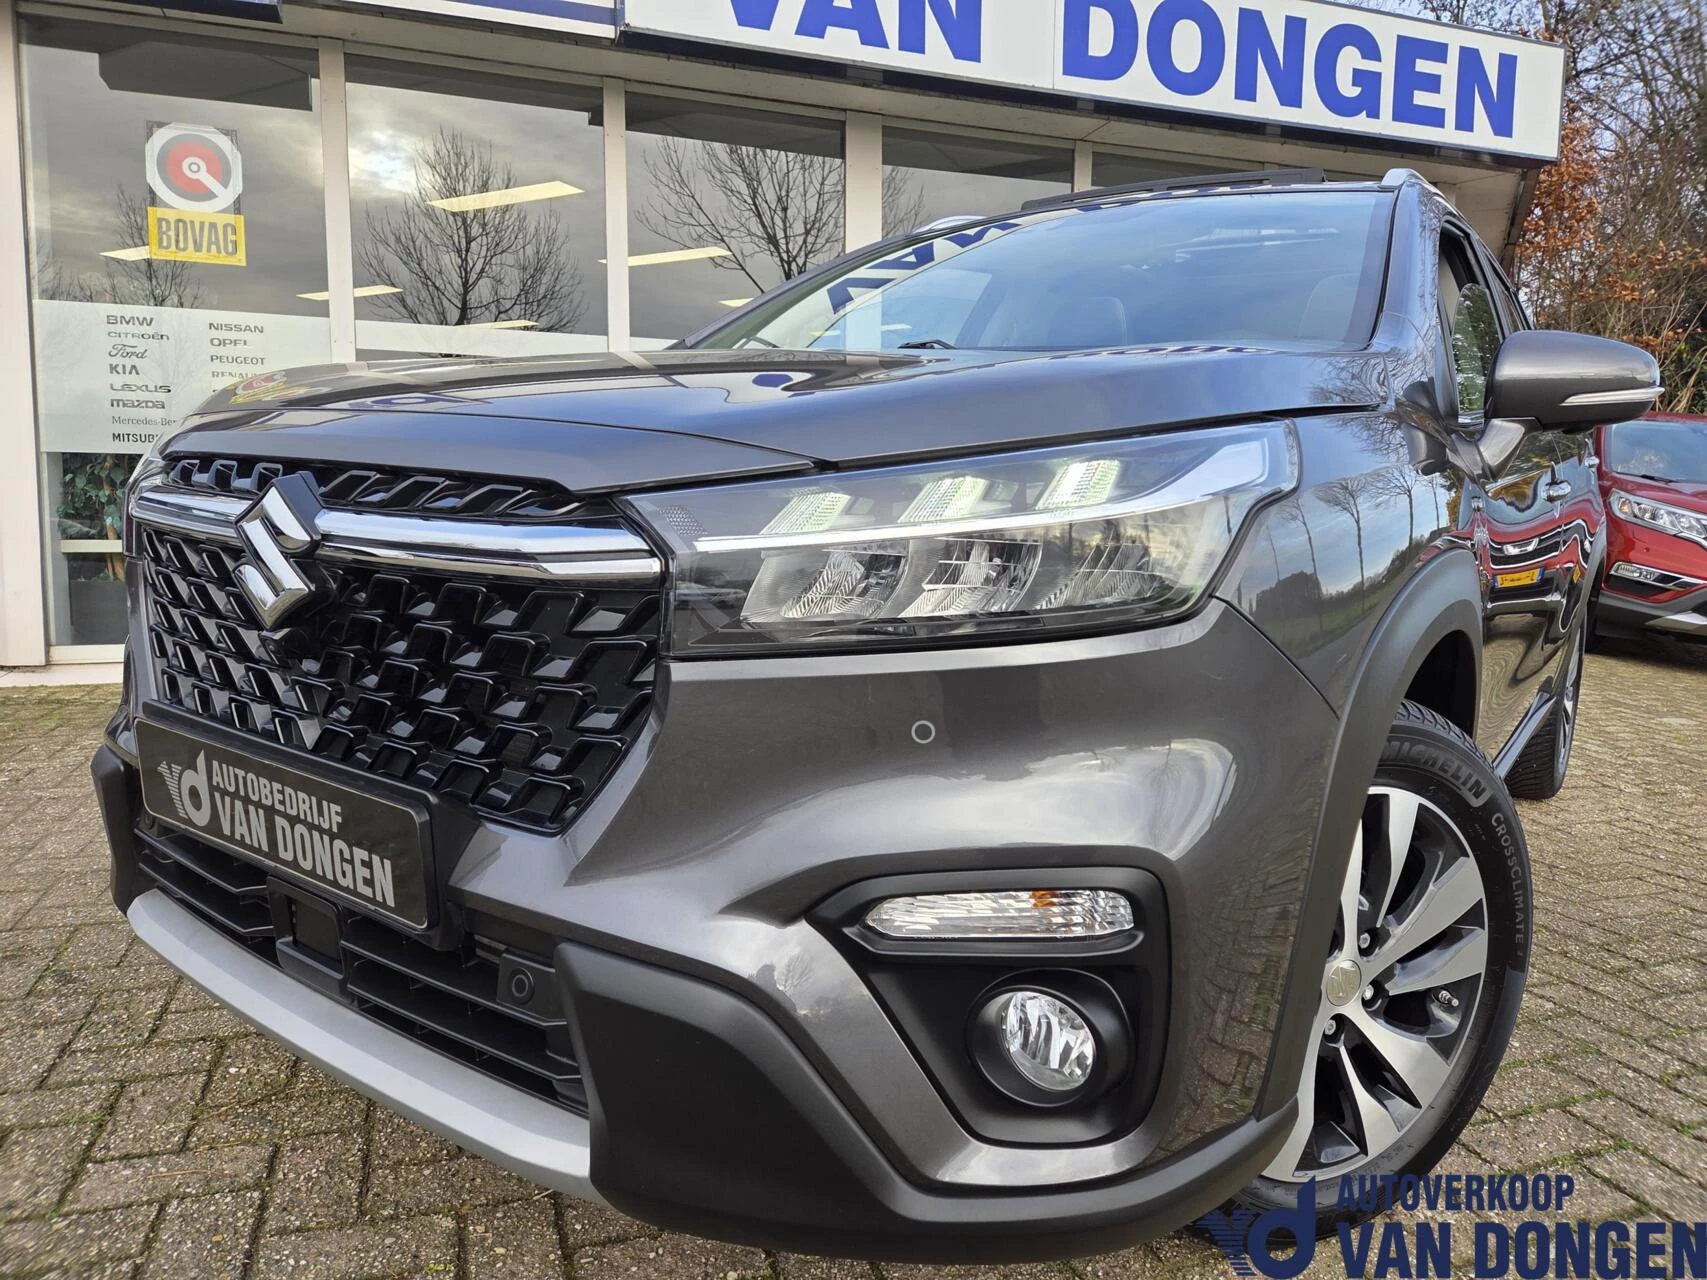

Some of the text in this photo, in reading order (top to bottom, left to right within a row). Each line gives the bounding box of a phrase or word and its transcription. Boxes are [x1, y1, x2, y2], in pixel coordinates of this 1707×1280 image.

[1063, 0, 1516, 138] DONGEN
[157, 217, 238, 256] BOVAG
[106, 315, 154, 327] BMW
[208, 322, 264, 333] NISSAN
[108, 343, 149, 360] Ford
[210, 355, 266, 365] PEUGEOT
[109, 363, 141, 376] KIA
[110, 384, 172, 394] LEXUS
[112, 433, 159, 444] MITSUB
[212, 760, 342, 833] AUTOBEDRIJF
[214, 791, 395, 908] VAN DONGEN
